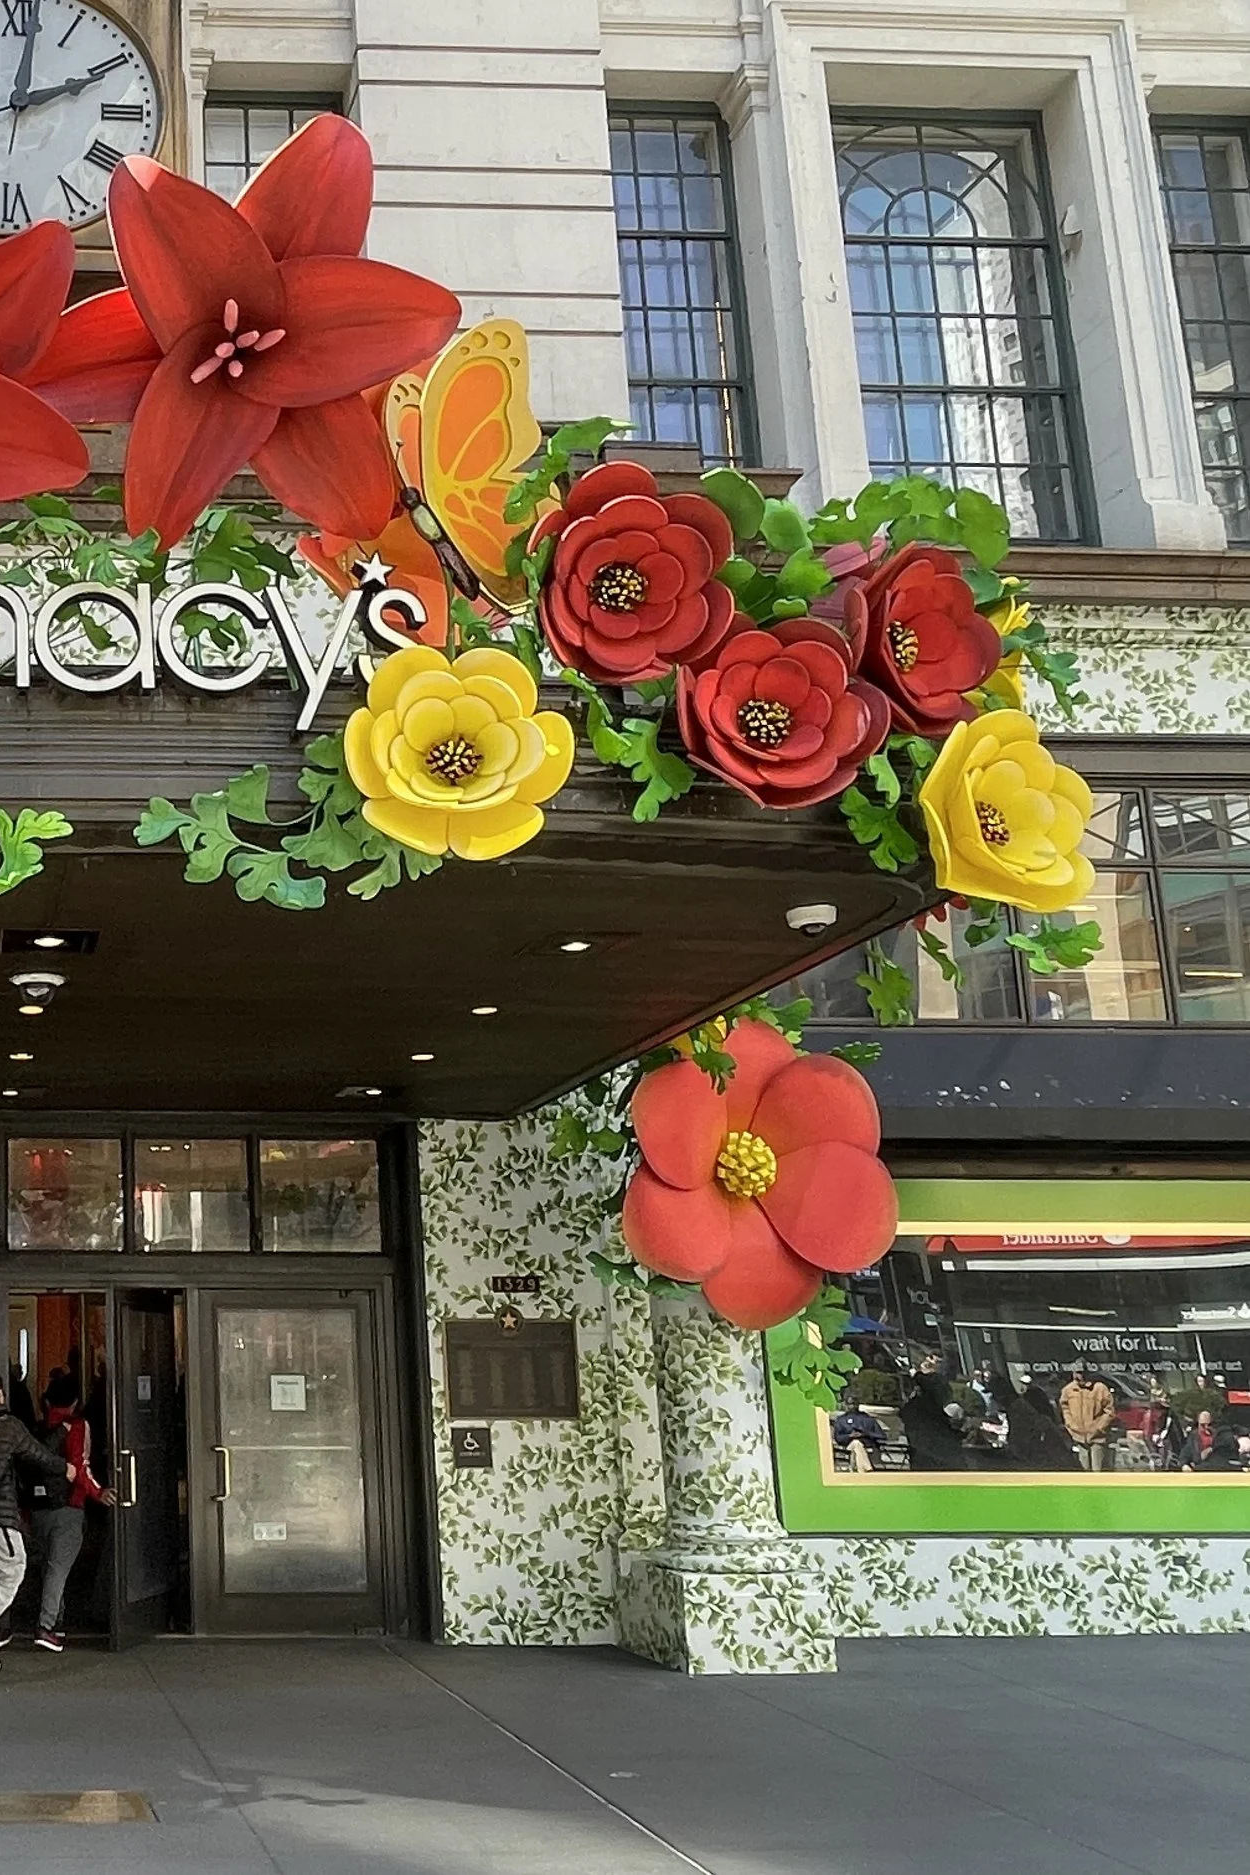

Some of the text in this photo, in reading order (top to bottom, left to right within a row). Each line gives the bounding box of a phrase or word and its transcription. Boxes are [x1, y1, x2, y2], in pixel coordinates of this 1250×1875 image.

[87, 53, 129, 76] II
[101, 103, 143, 122] III
[2, 182, 32, 223] VI
[57, 175, 91, 213] V
[497, 1278, 536, 1291] 1329
[1072, 1335, 1109, 1351] wait
[1114, 1335, 1141, 1351] for
[1086, 1361, 1099, 1372] to
[1129, 1362, 1150, 1374] you
[1152, 1360, 1177, 1372] with
[1179, 1361, 1198, 1372] our
